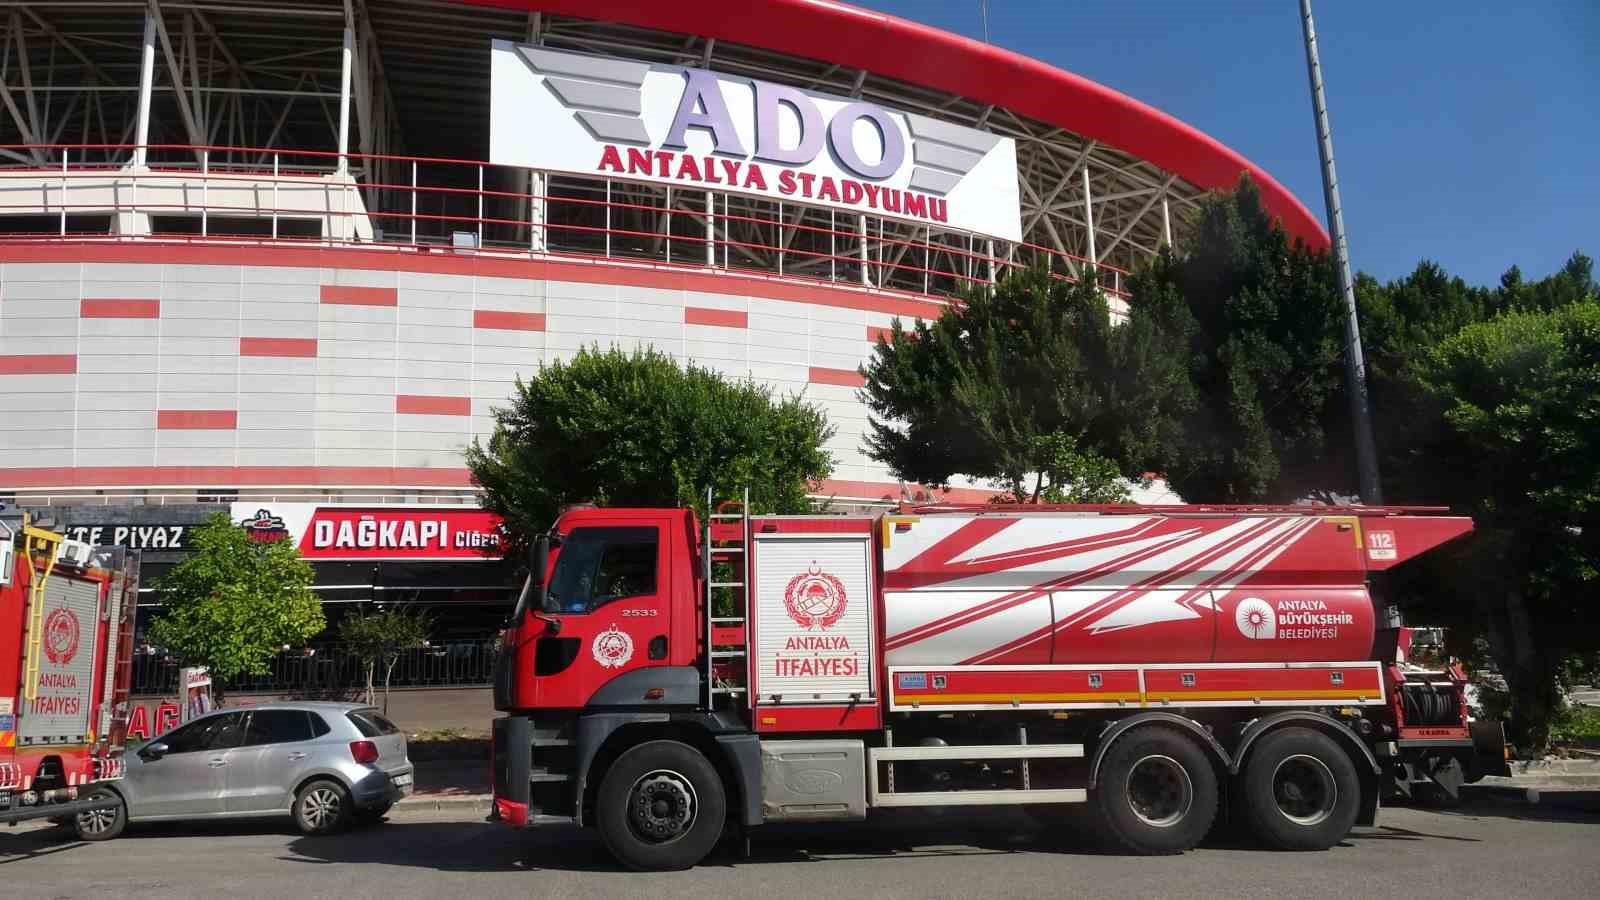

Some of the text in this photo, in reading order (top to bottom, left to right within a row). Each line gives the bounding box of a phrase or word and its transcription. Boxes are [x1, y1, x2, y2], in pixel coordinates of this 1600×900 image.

[658, 69, 905, 182] ADO
[597, 144, 949, 226] ANTALYA STADYUMU
[64, 526, 104, 547] TE
[314, 514, 449, 549] DAĞKAPI
[1368, 533, 1393, 548] 112
[621, 609, 658, 617] 2533
[1277, 600, 1327, 611] ANTALYA
[1279, 610, 1354, 627] BÜYÜKŞEHİR
[1279, 626, 1338, 640] BELEDİYESİ
[785, 637, 850, 650] ANTALYA
[775, 652, 859, 676] İTFAİYESİ
[38, 674, 77, 689] ANTALYA
